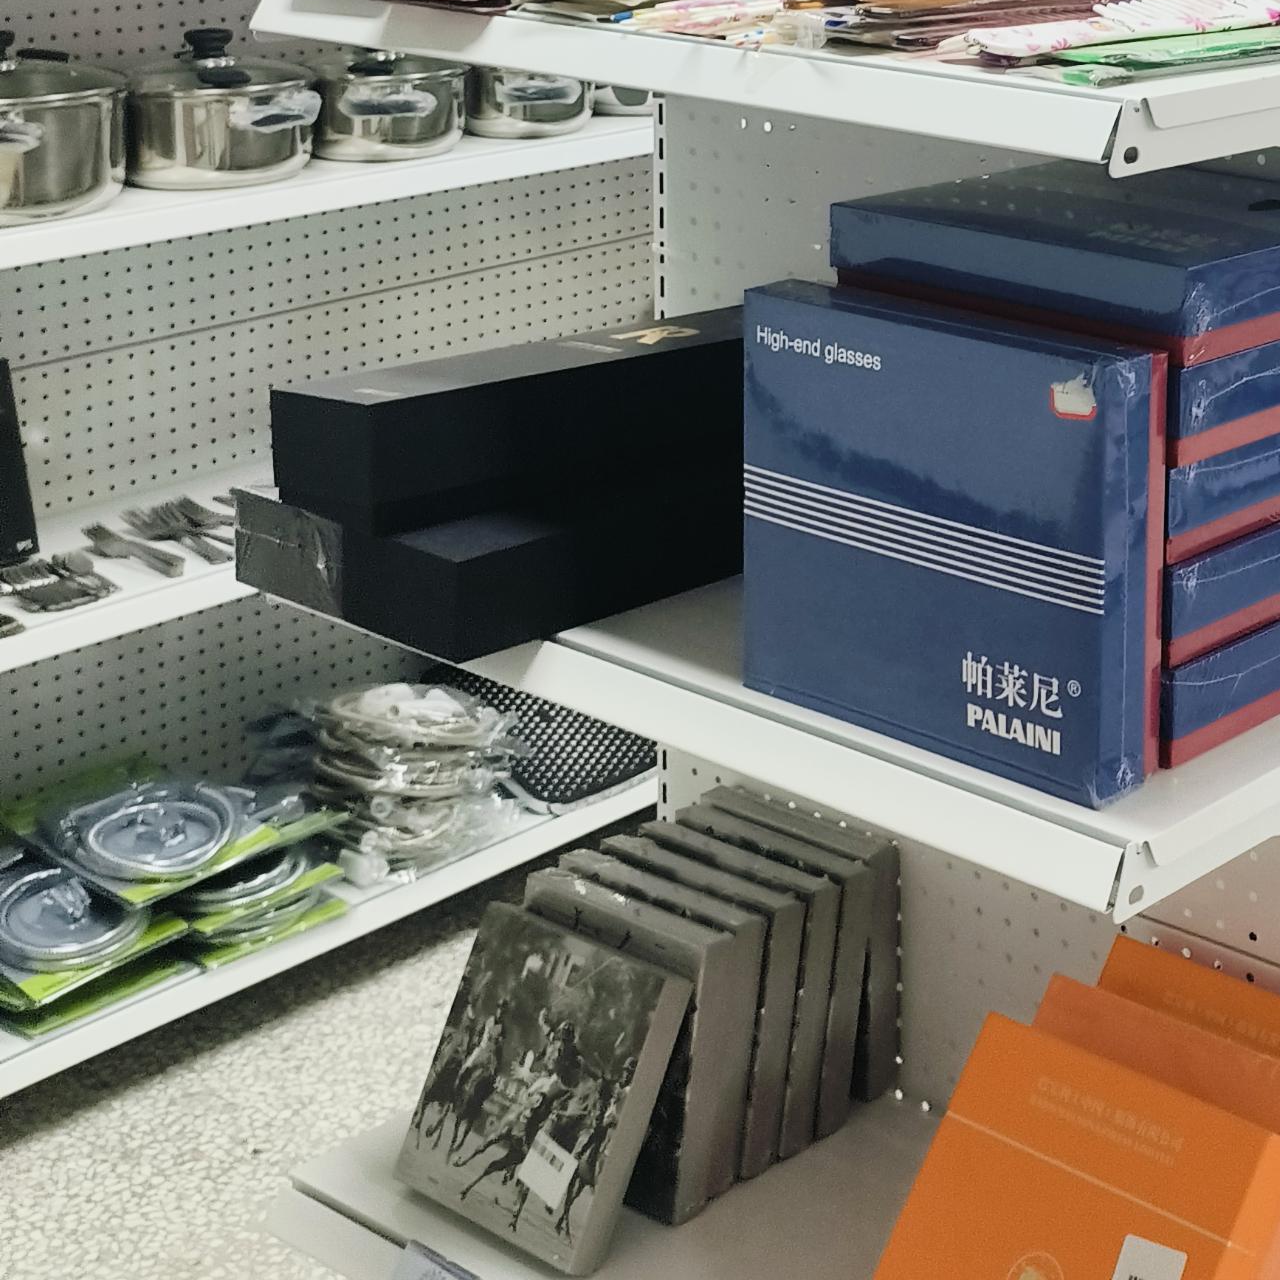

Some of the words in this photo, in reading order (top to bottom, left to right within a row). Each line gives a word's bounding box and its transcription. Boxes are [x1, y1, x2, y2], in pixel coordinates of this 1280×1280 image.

[756, 325, 821, 358] High-end
[824, 342, 882, 371] glasses
[962, 651, 1063, 718] 帕莱尼
[967, 702, 1061, 756] PALAINI
